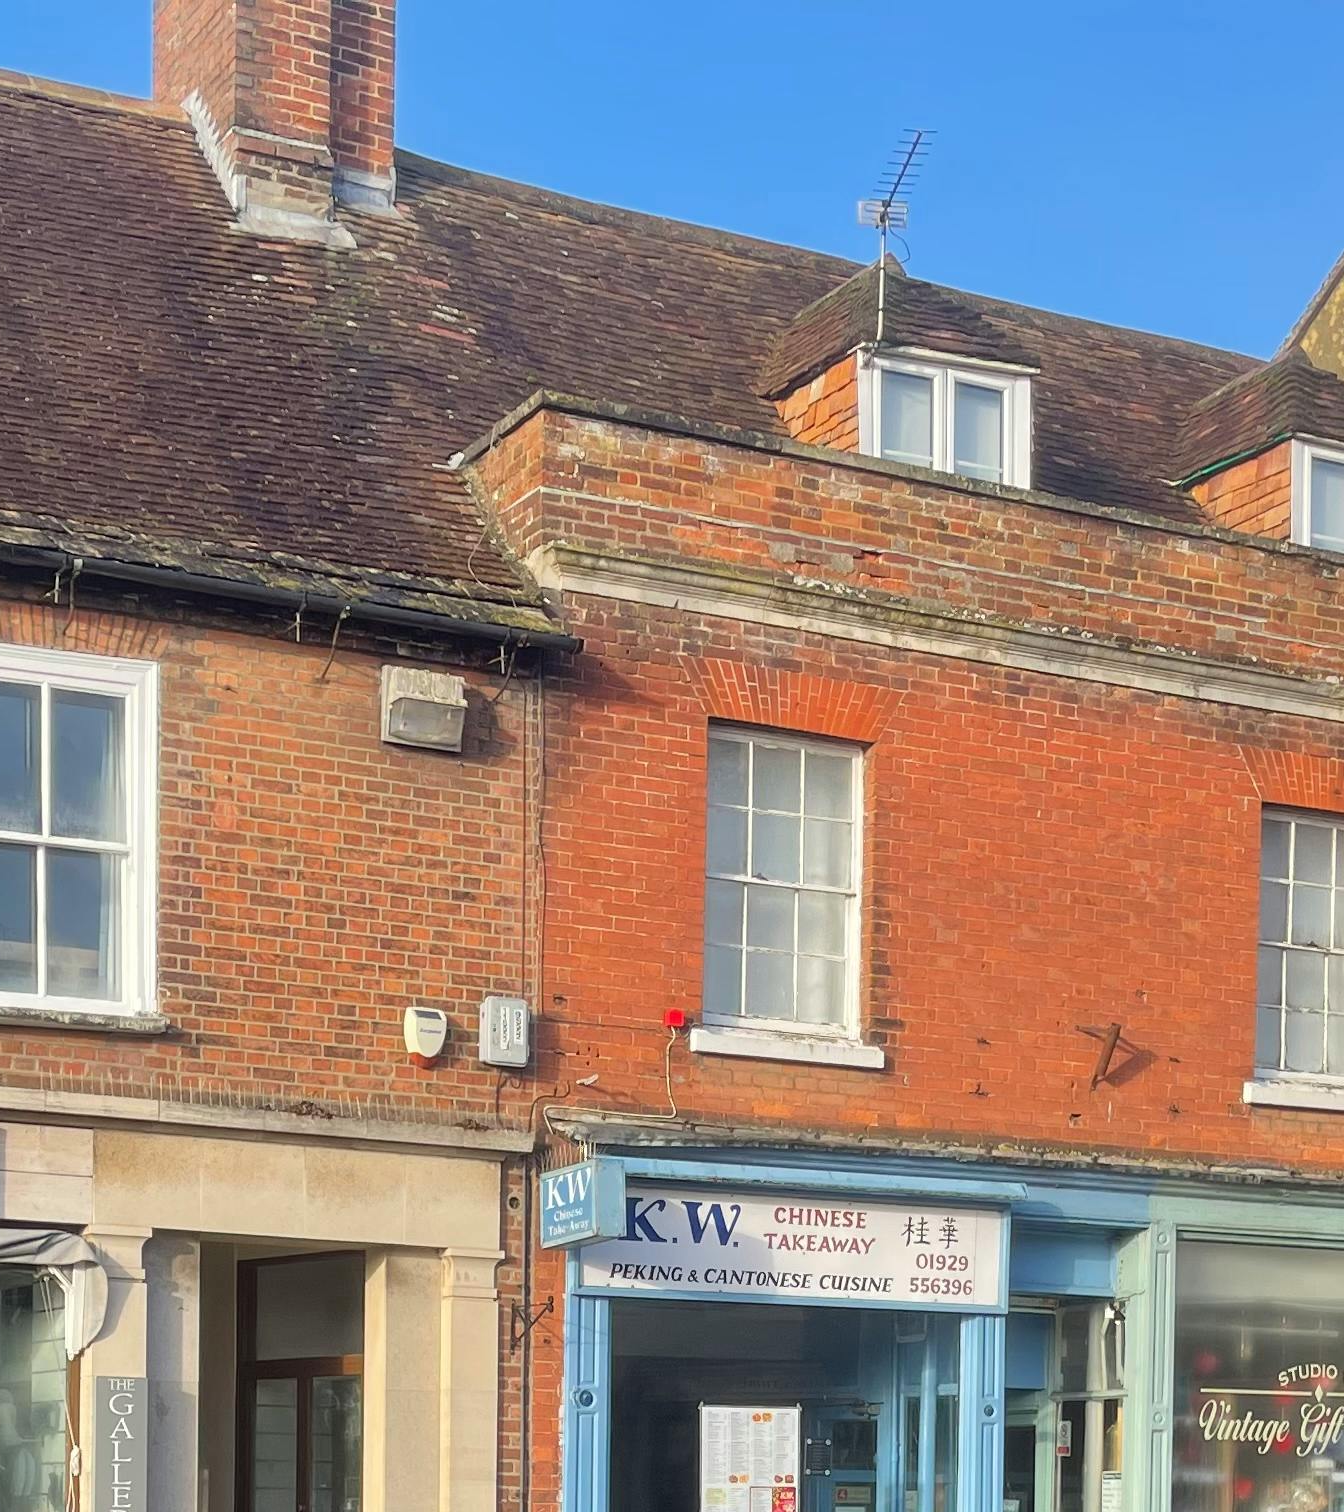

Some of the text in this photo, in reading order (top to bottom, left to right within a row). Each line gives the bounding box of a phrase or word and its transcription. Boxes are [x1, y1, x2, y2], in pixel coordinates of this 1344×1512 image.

[545, 1167, 592, 1210] KW
[617, 1197, 742, 1248] K.W.
[774, 1207, 868, 1229] CHINESE
[763, 1233, 876, 1255] TAKEAWAY
[915, 1253, 969, 1272] 01929
[609, 1263, 894, 1293] PEKING & CANTONESE CUISINE
[909, 1277, 973, 1296] 556396
[108, 1378, 136, 1391] THE
[1278, 1363, 1338, 1387] STUDIO
[1198, 1399, 1290, 1455] Vintage
